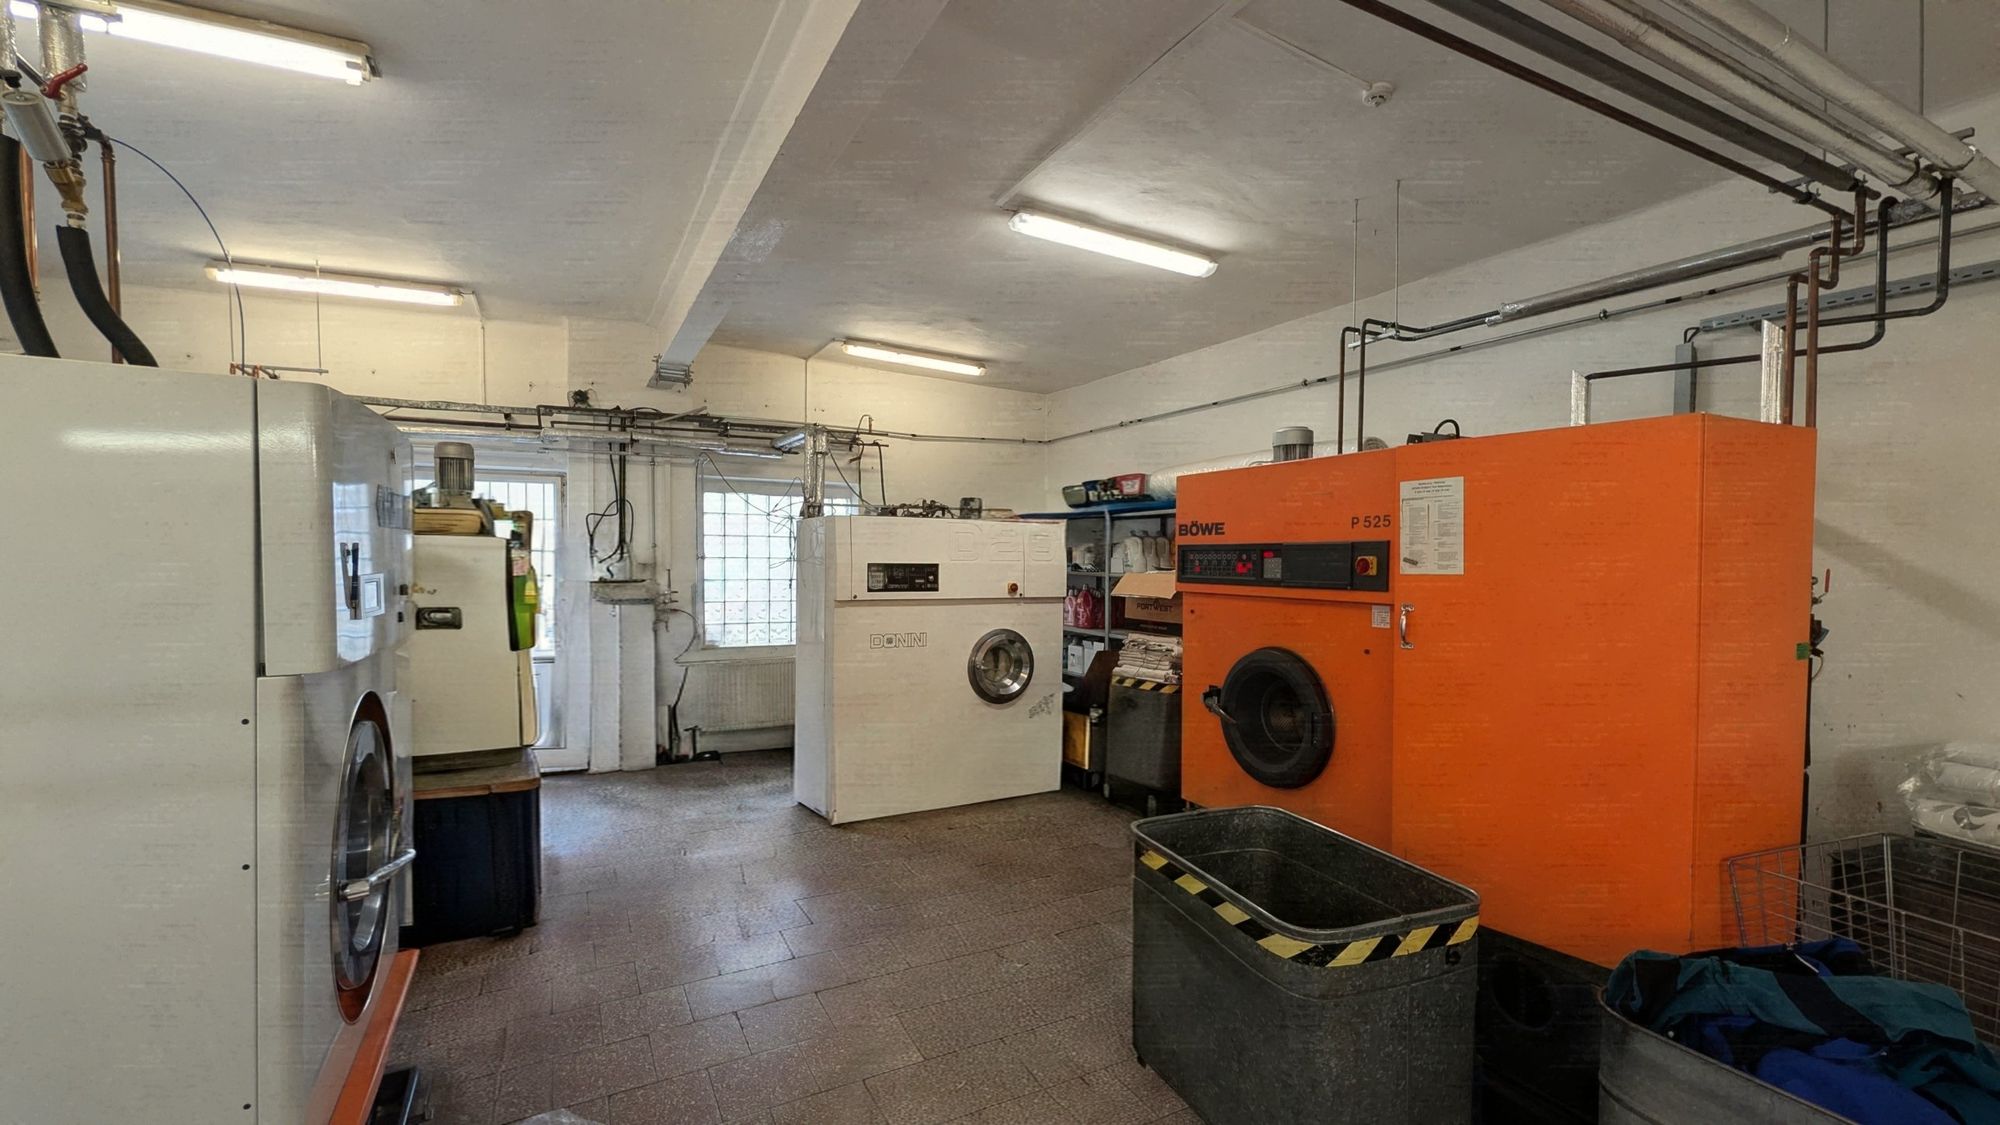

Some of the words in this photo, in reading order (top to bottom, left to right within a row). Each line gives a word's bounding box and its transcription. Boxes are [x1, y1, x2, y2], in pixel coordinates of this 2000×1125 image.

[1178, 520, 1226, 537] BÖWE
[1352, 516, 1360, 530] P
[1363, 514, 1392, 529] 525
[869, 631, 928, 650] DONINI
